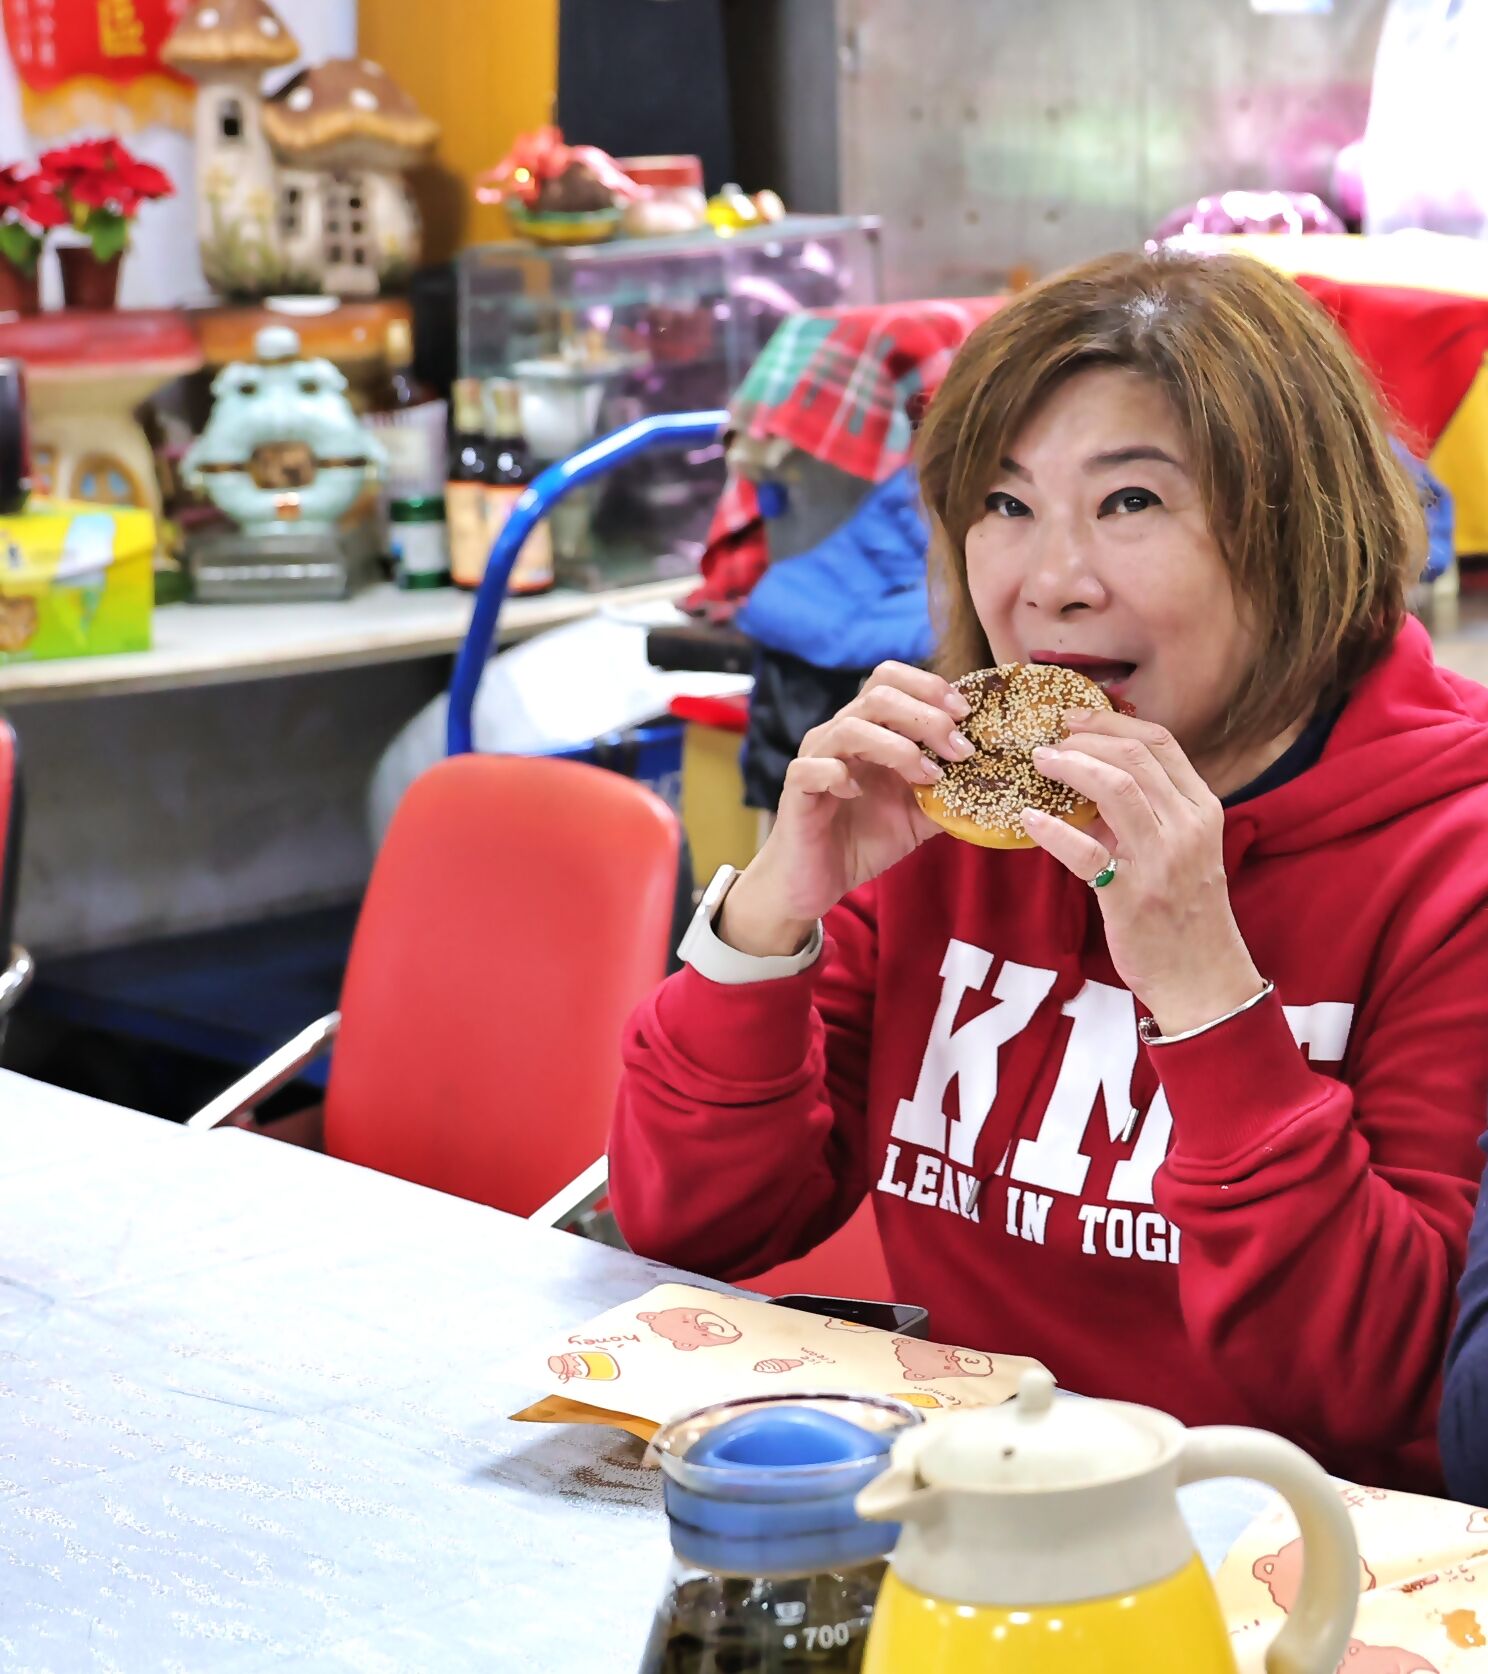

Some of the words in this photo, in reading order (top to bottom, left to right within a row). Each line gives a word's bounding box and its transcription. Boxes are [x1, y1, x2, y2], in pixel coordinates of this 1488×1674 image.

[1005, 1186, 1054, 1246] IN
[568, 1333, 641, 1347] honey
[802, 1622, 850, 1652] 700
